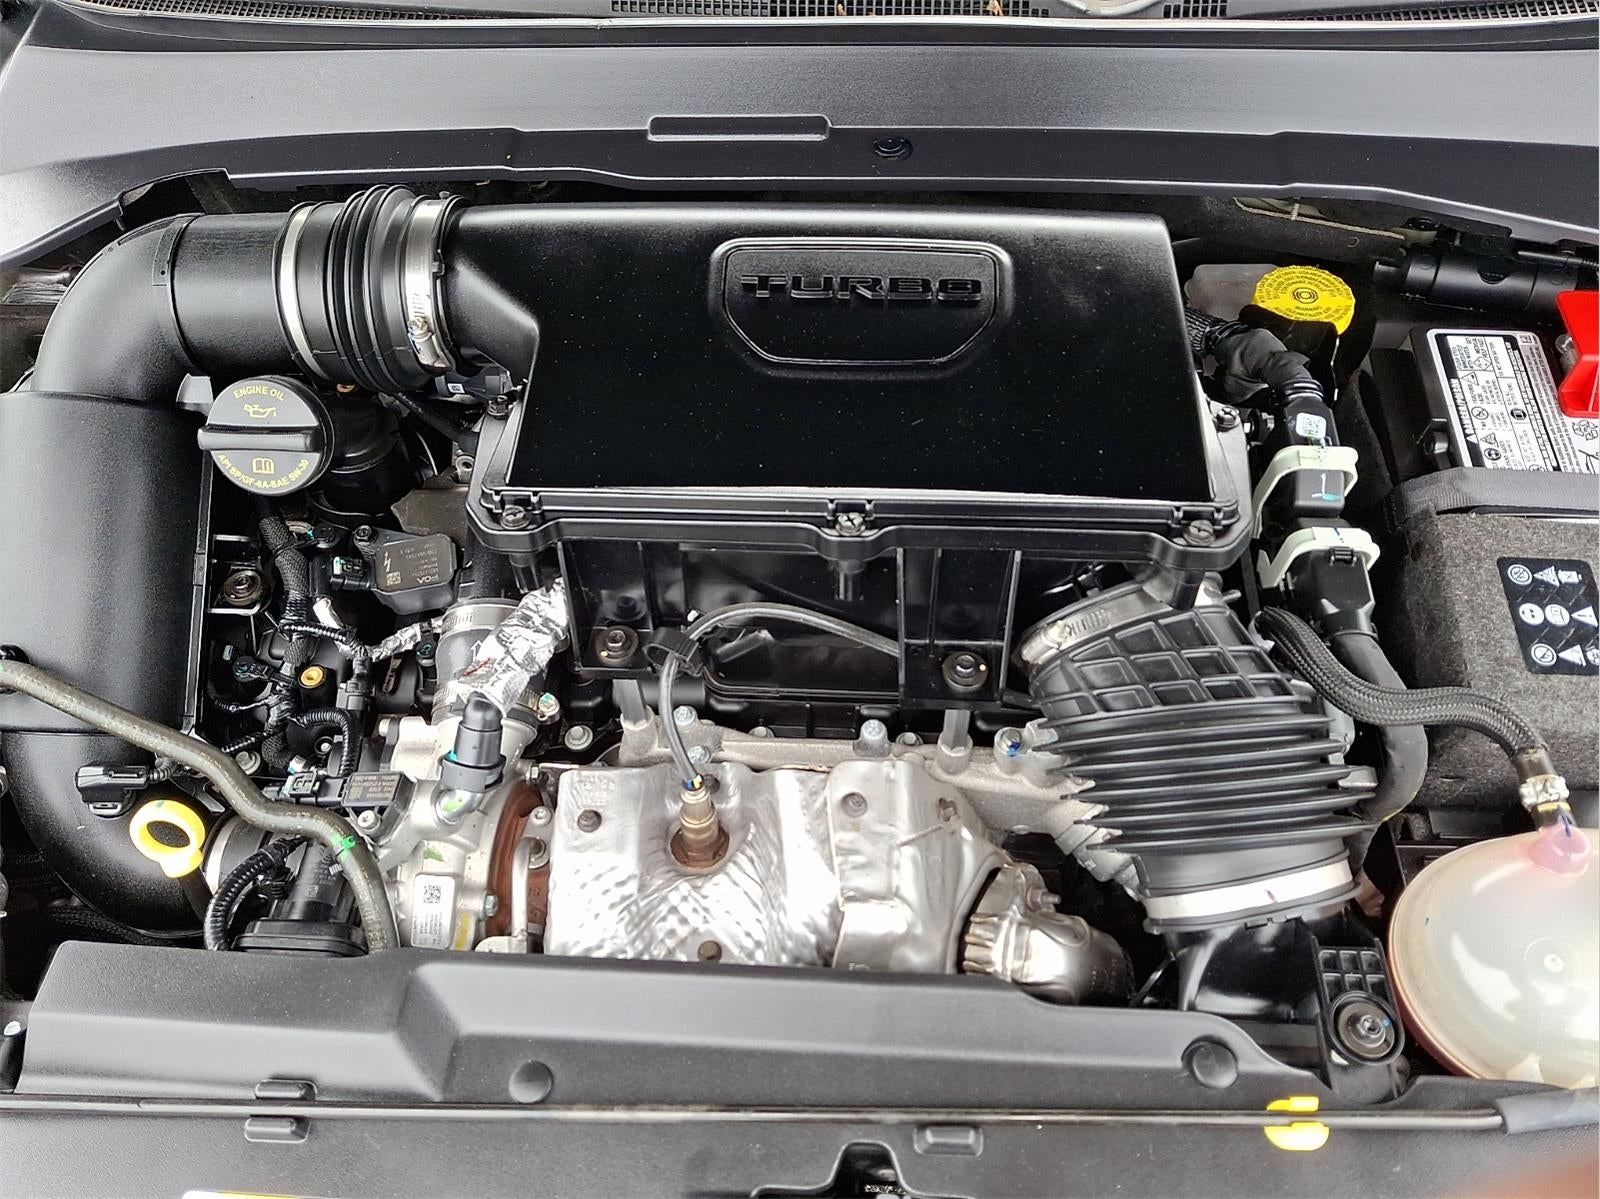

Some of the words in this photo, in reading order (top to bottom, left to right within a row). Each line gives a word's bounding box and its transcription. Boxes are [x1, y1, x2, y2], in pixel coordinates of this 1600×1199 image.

[741, 274, 983, 303] TURBO
[233, 385, 268, 399] ENGINE
[270, 388, 285, 401] OIL
[218, 454, 232, 471] API
